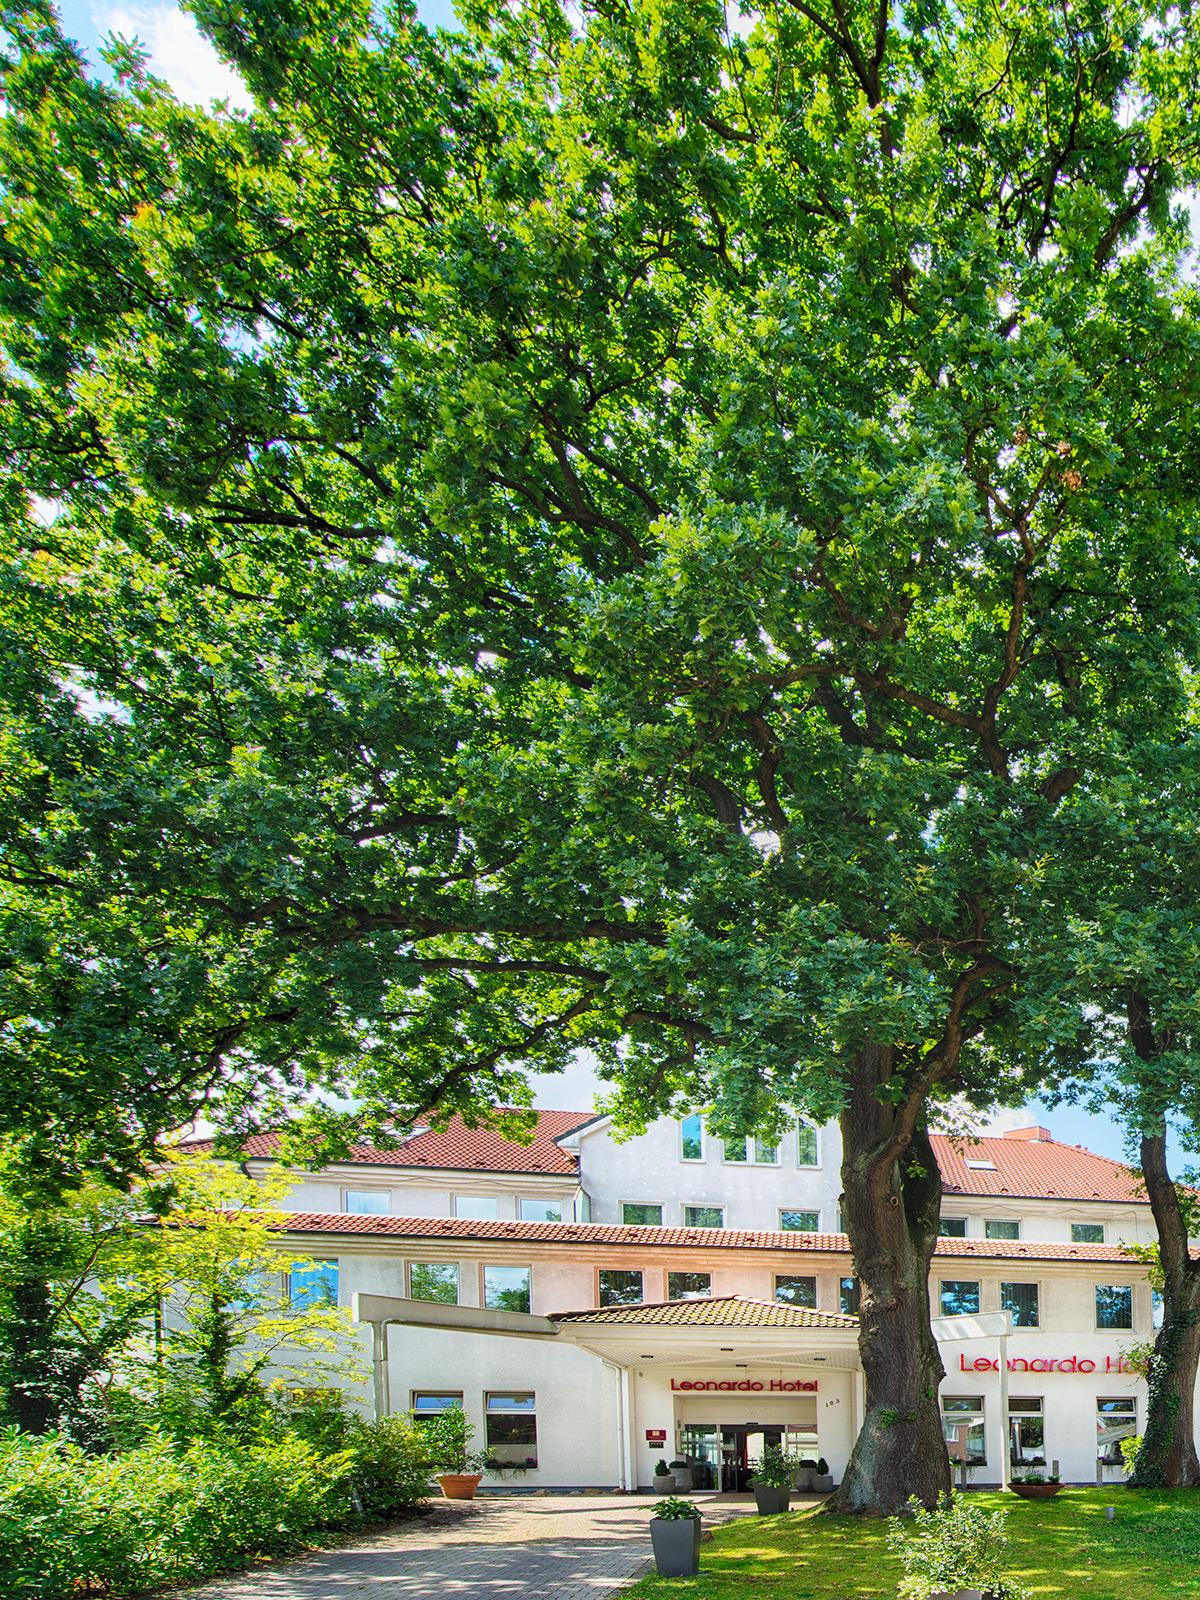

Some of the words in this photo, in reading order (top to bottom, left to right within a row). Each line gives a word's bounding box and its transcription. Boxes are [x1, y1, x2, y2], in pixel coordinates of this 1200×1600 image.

[960, 1353, 1096, 1374] Leonardo
[671, 1378, 764, 1392] Leonardo
[770, 1379, 818, 1392] Hotel
